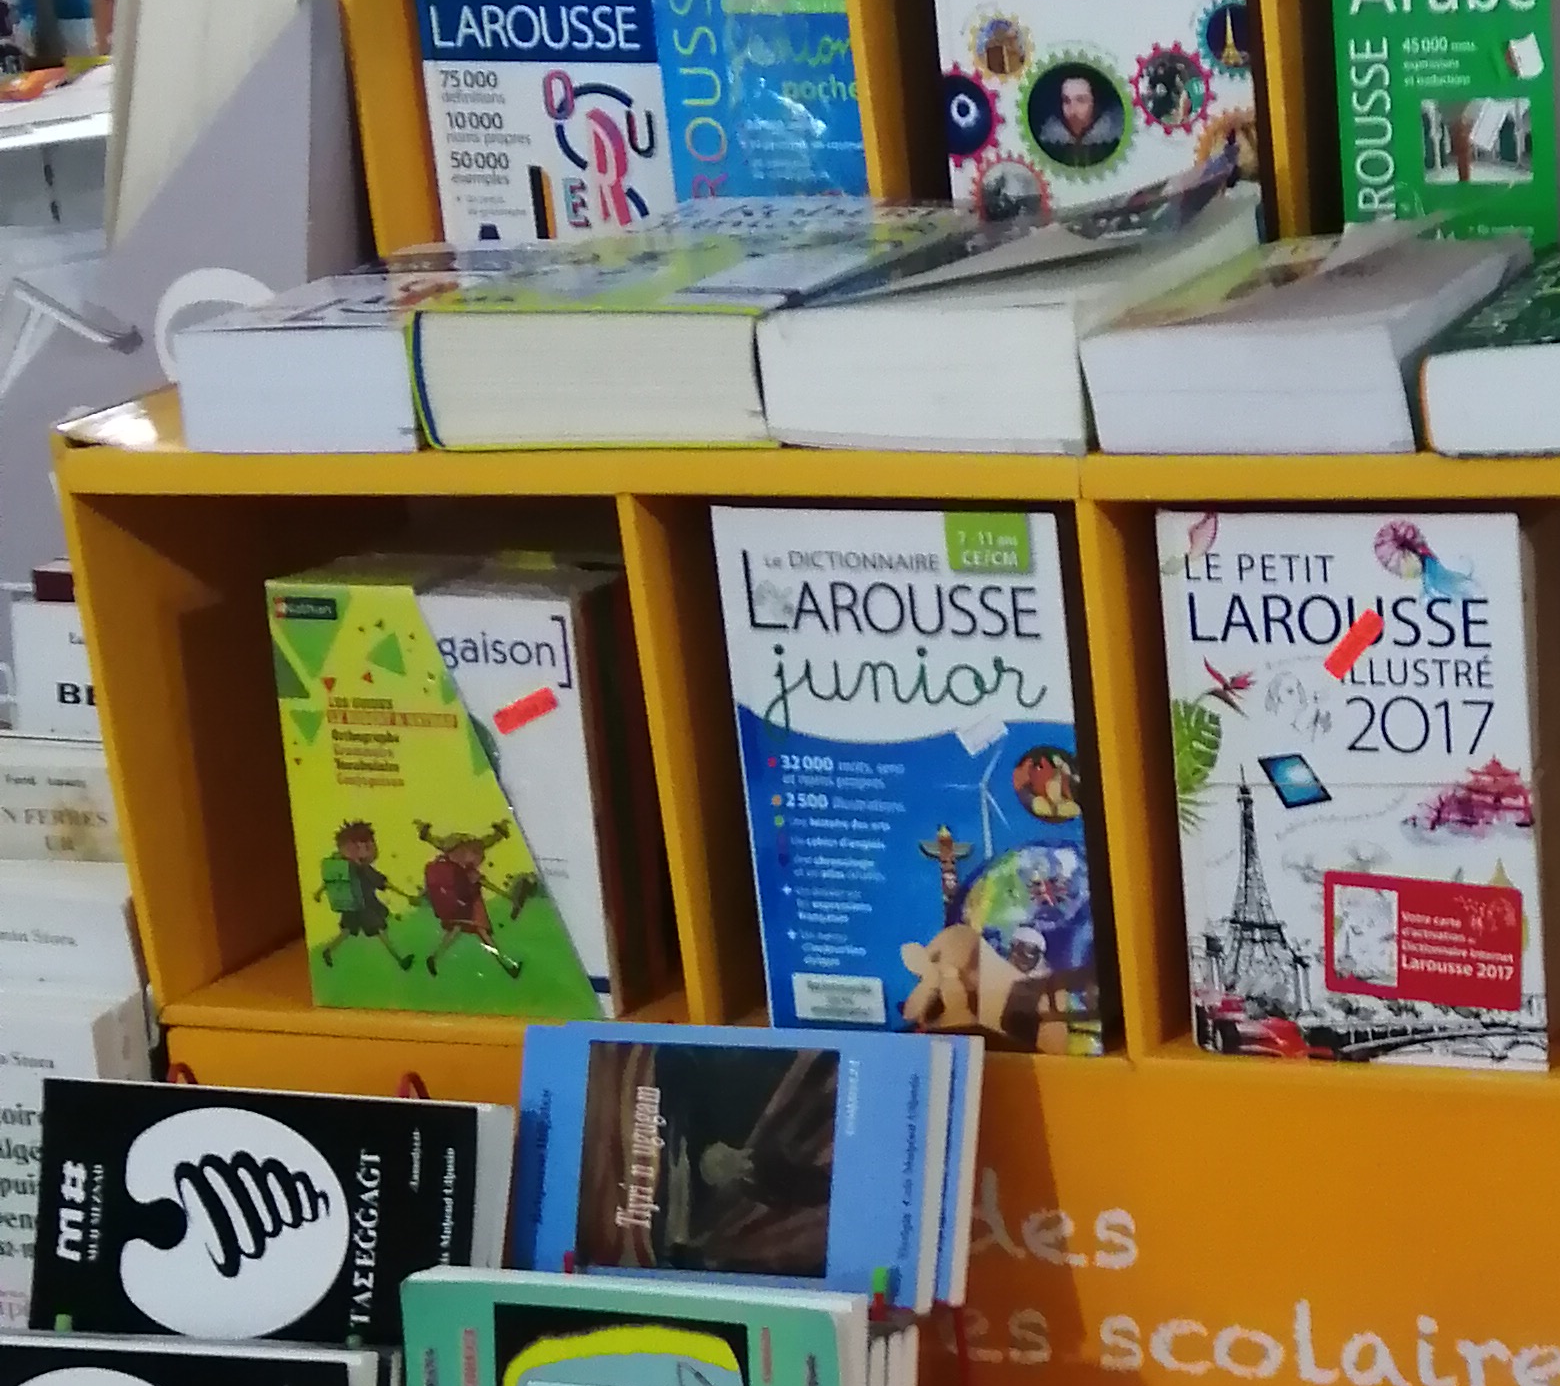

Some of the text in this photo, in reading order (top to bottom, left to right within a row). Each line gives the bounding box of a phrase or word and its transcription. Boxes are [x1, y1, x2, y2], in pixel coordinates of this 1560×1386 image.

[428, 3, 641, 51] LAROUSSE
[788, 551, 940, 572] DICTIONNAIRE
[1184, 553, 1335, 584] LE PETIT
[742, 549, 1042, 640] LAROUSSE
[1340, 656, 1495, 689] LLUSTRÉ
[763, 644, 1048, 744] junior
[1346, 696, 1495, 755] 2017
[1401, 958, 1514, 983] Larousse 2017
